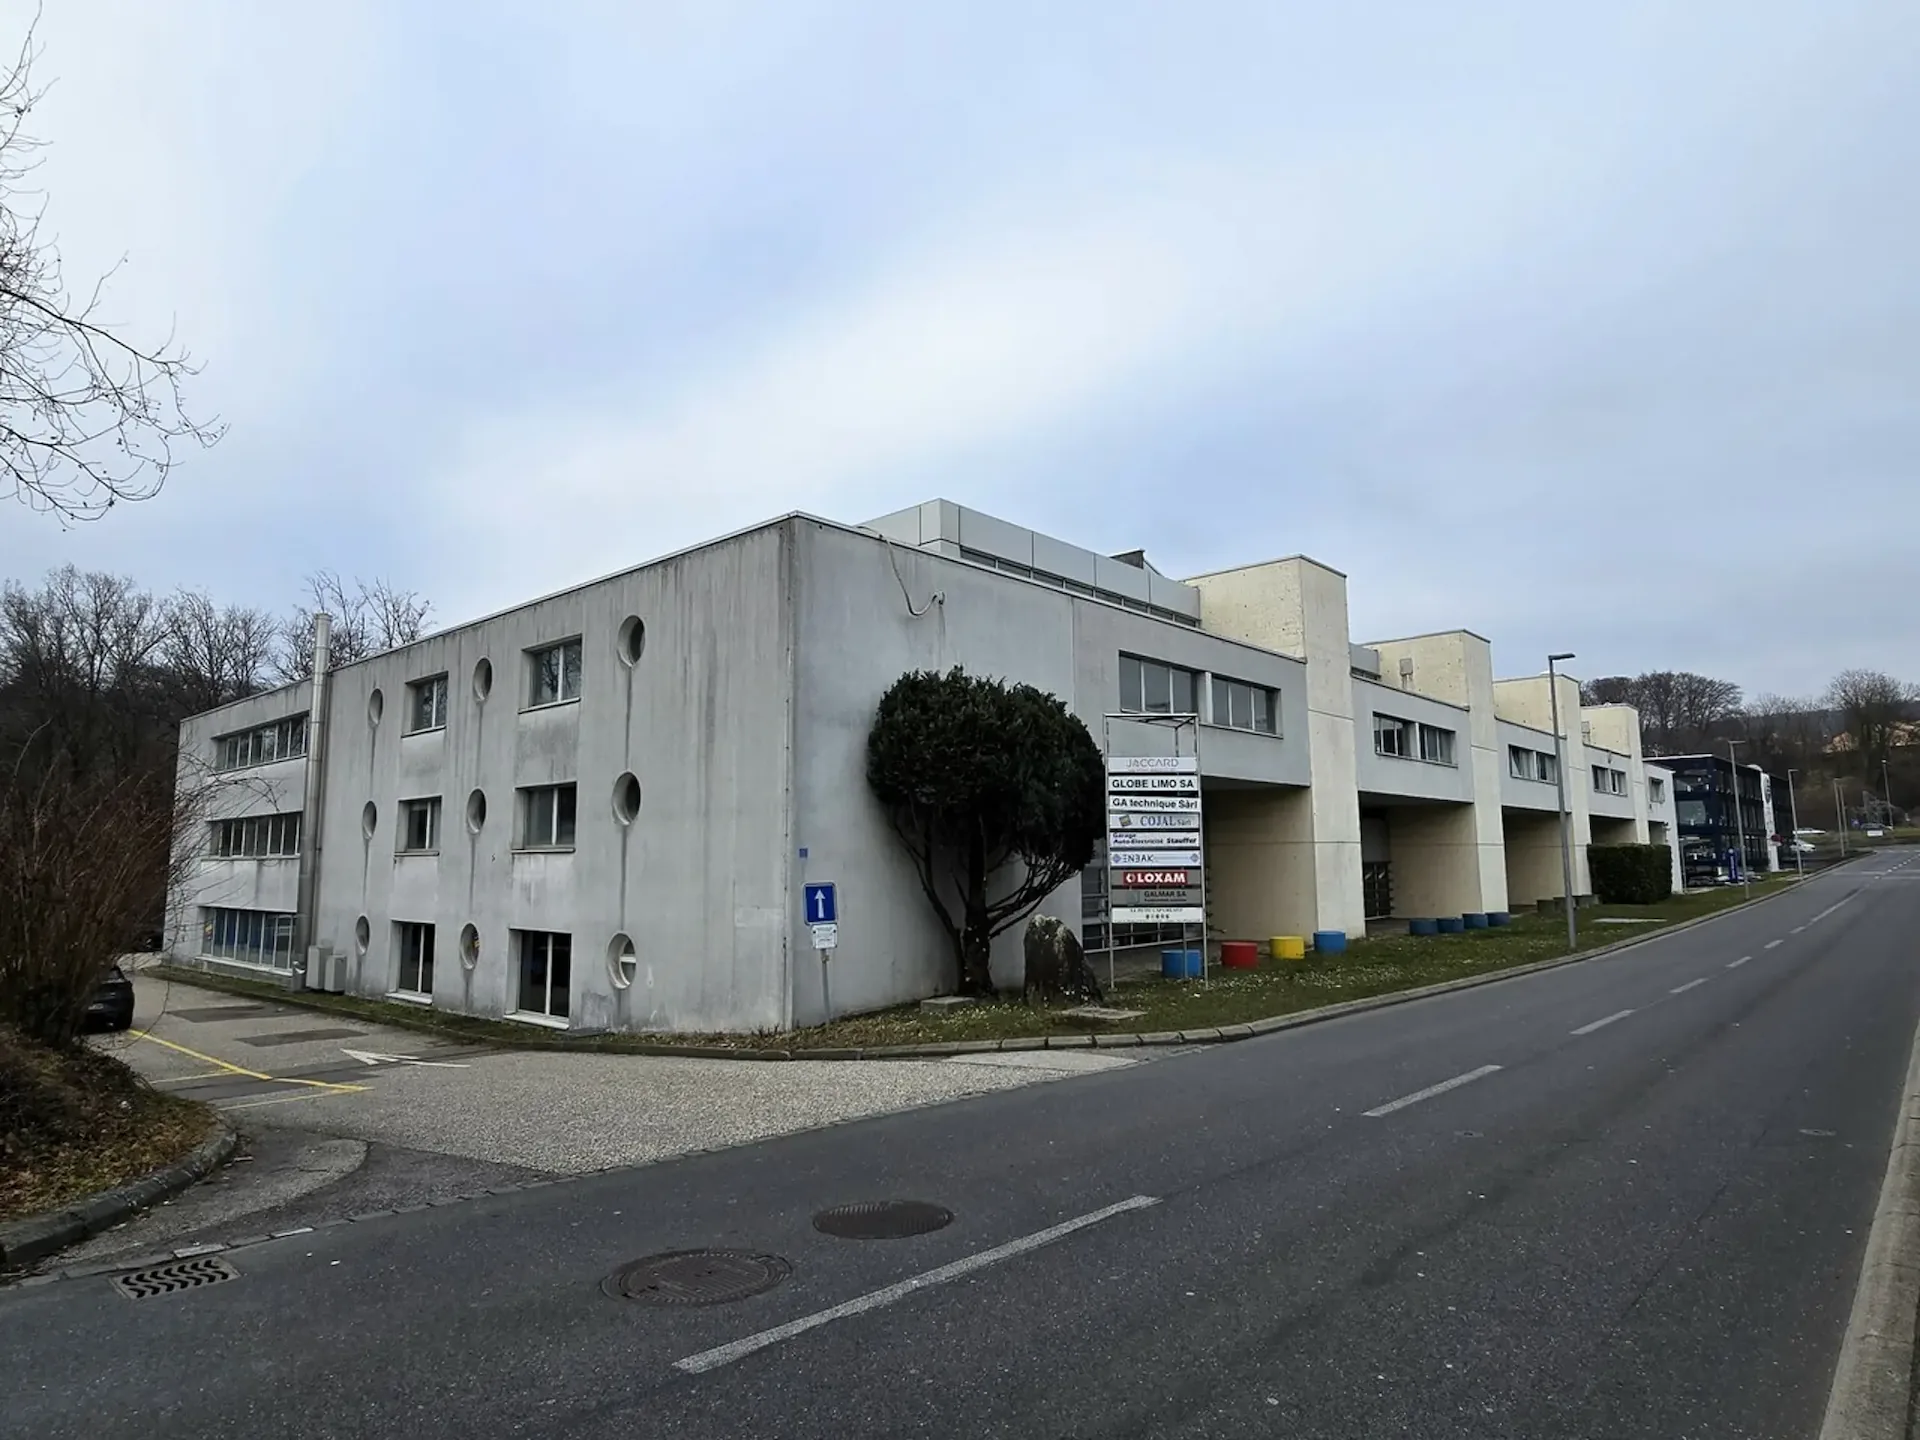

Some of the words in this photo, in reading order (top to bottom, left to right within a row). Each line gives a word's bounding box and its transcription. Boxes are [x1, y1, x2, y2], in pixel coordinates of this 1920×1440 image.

[1126, 758, 1179, 768] JACCARD
[1112, 779, 1148, 788] GLOBE
[1151, 779, 1177, 788] LIMO
[1179, 779, 1194, 788] SA
[1112, 798, 1127, 807] GA
[1130, 799, 1176, 809] technique
[1140, 815, 1176, 826] COJAL
[1137, 872, 1186, 883] LOXAM
